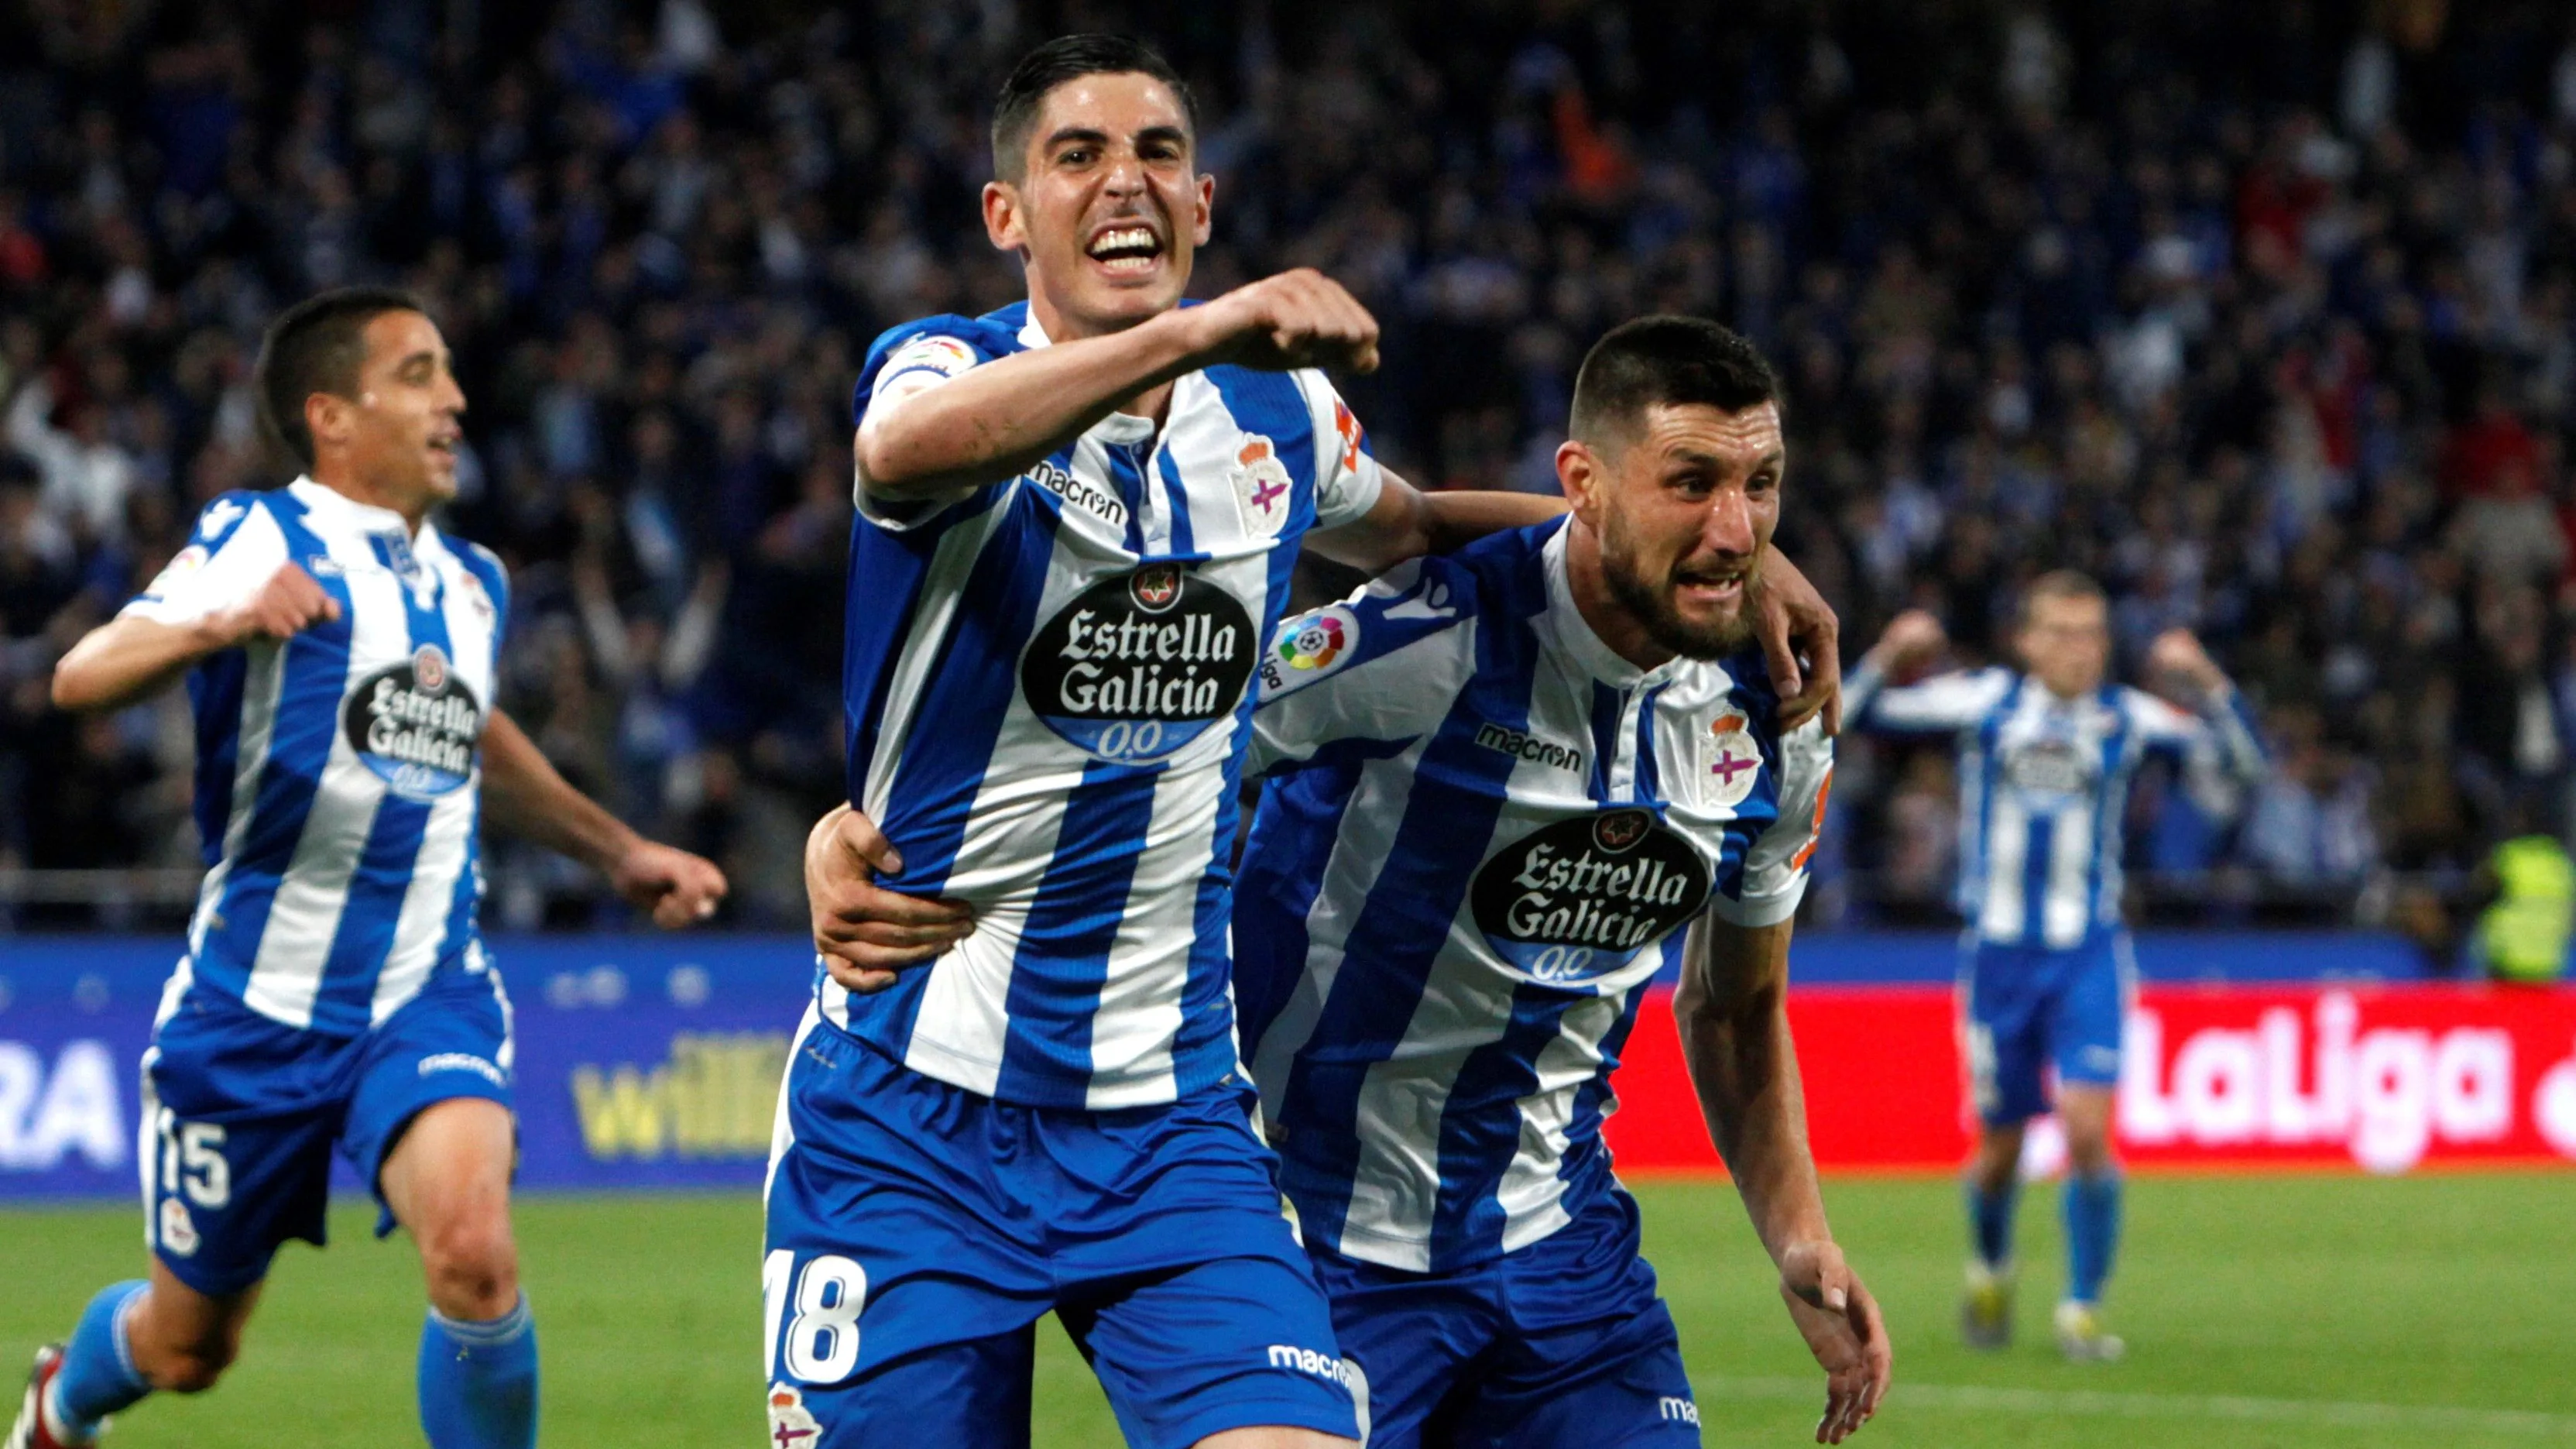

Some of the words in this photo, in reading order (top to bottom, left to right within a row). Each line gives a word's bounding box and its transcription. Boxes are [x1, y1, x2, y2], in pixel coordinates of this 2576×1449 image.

[1058, 608, 1237, 662] Estrella
[366, 675, 478, 737] Estrella
[1059, 661, 1219, 716] Galicia
[367, 713, 471, 774] Galicia
[1477, 724, 1582, 773] macron
[1511, 842, 1688, 906] Estrella
[1507, 891, 1658, 947] Galicia
[158, 1108, 232, 1208] 15
[763, 1248, 868, 1385] 18
